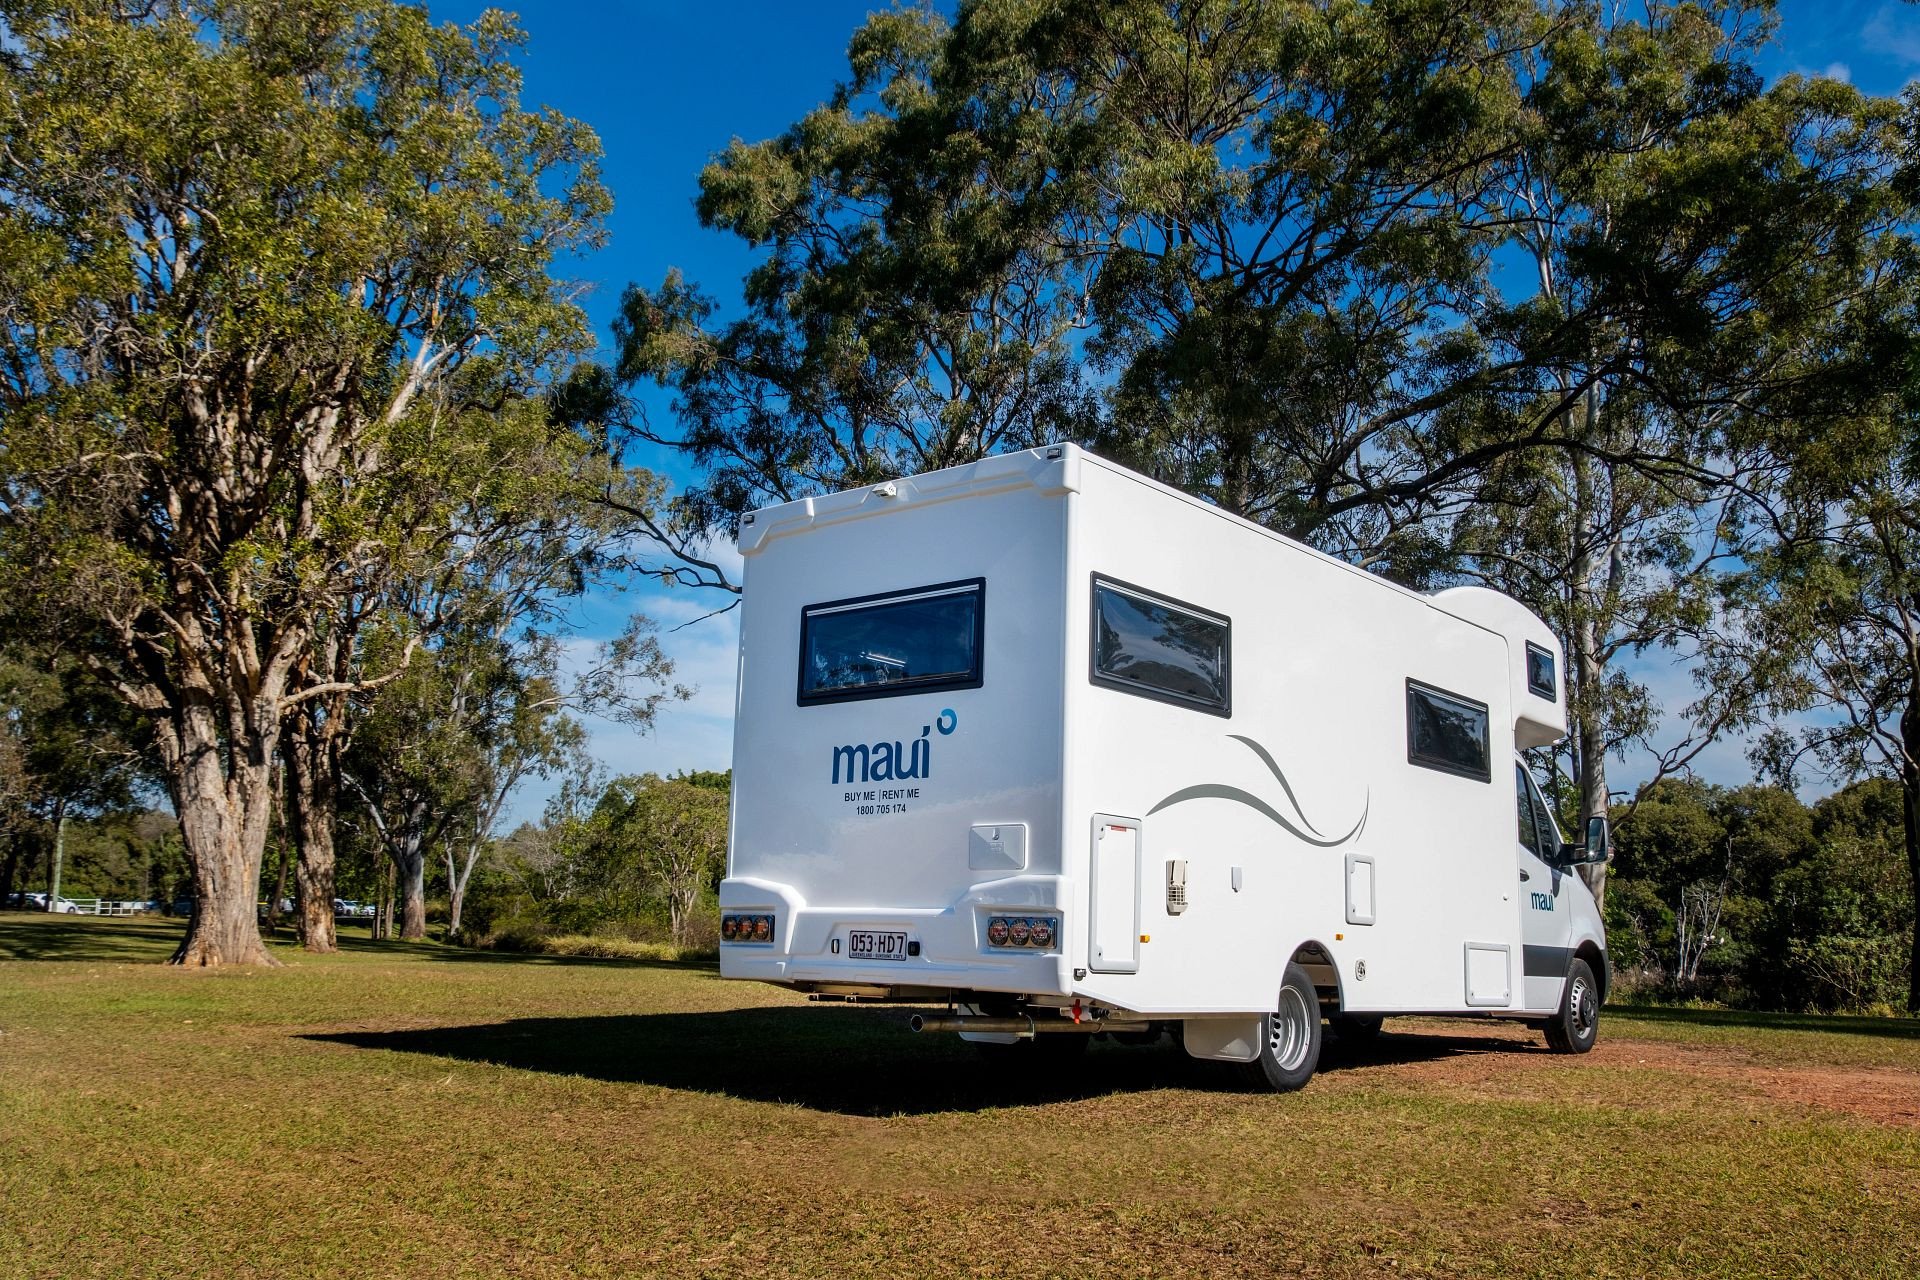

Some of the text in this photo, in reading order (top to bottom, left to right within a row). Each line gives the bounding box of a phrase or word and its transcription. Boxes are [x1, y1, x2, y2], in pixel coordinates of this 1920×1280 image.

[844, 791, 861, 802] BUY
[863, 791, 875, 801] ME
[882, 789, 904, 800] RENT
[906, 788, 920, 798] ME
[856, 803, 906, 815] 1800 705 174
[1531, 889, 1554, 911] maui
